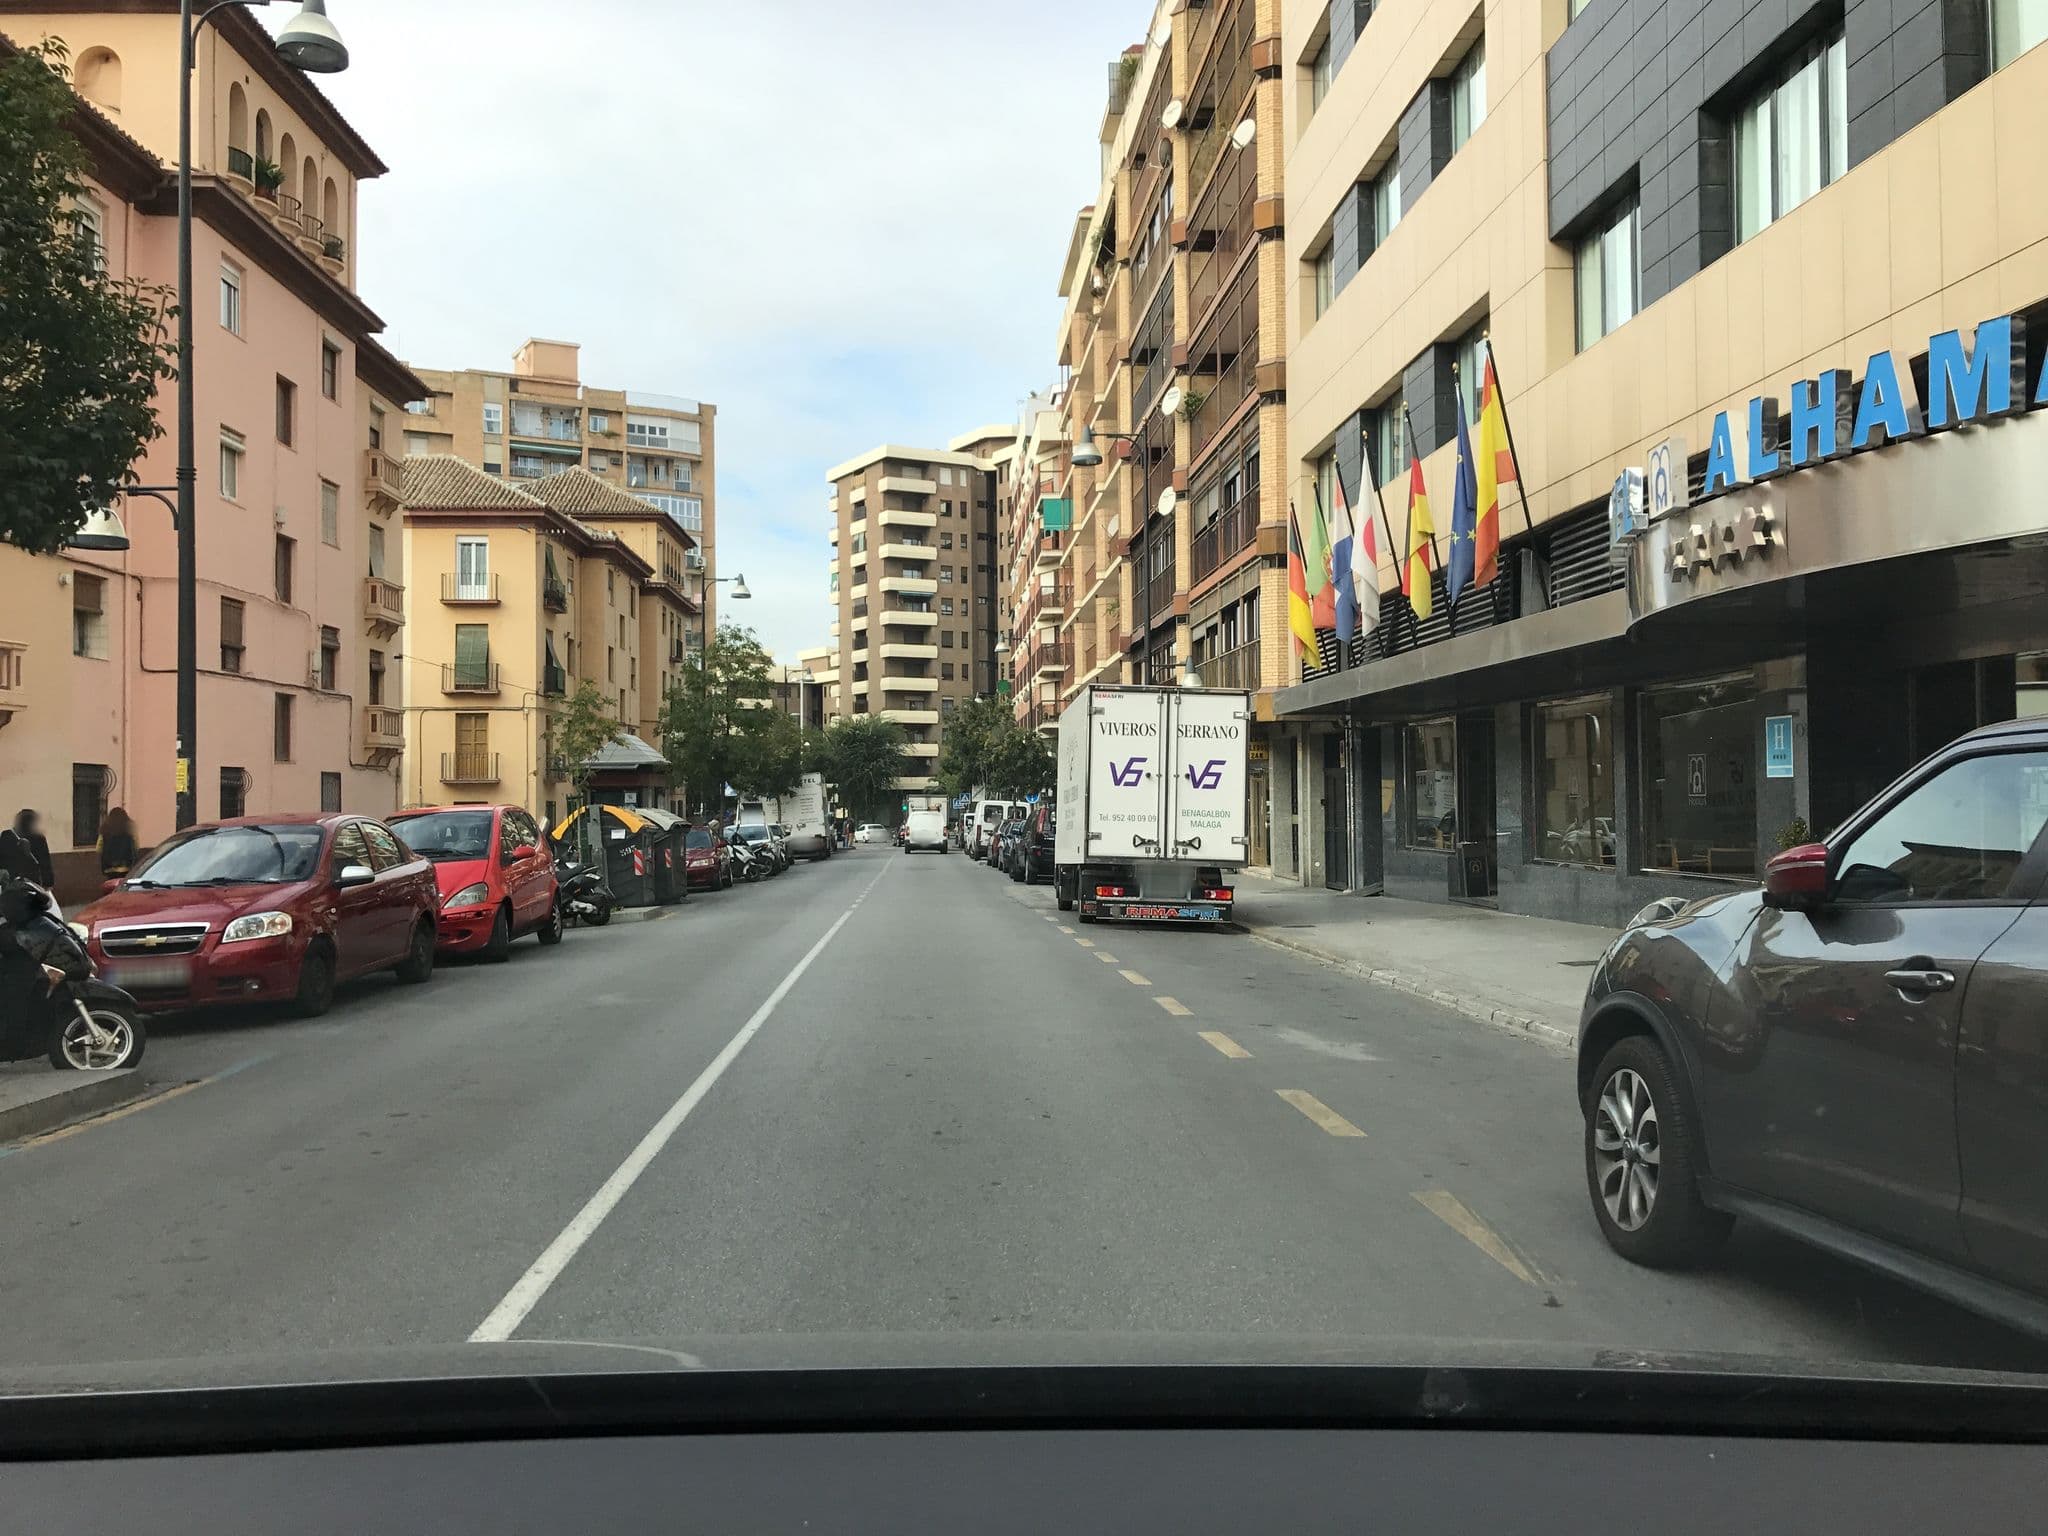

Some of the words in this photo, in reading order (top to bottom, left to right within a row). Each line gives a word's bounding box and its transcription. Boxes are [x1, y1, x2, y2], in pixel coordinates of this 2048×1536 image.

[1704, 314, 2048, 495] ALHAM
[1099, 722, 1157, 737] VIVEROS
[1177, 723, 1239, 739] SERRANO
[1099, 813, 1110, 822] Tel.
[1112, 814, 1125, 822] 952
[1127, 814, 1136, 823] 40
[1137, 814, 1146, 823] 09
[1148, 814, 1157, 823] 09
